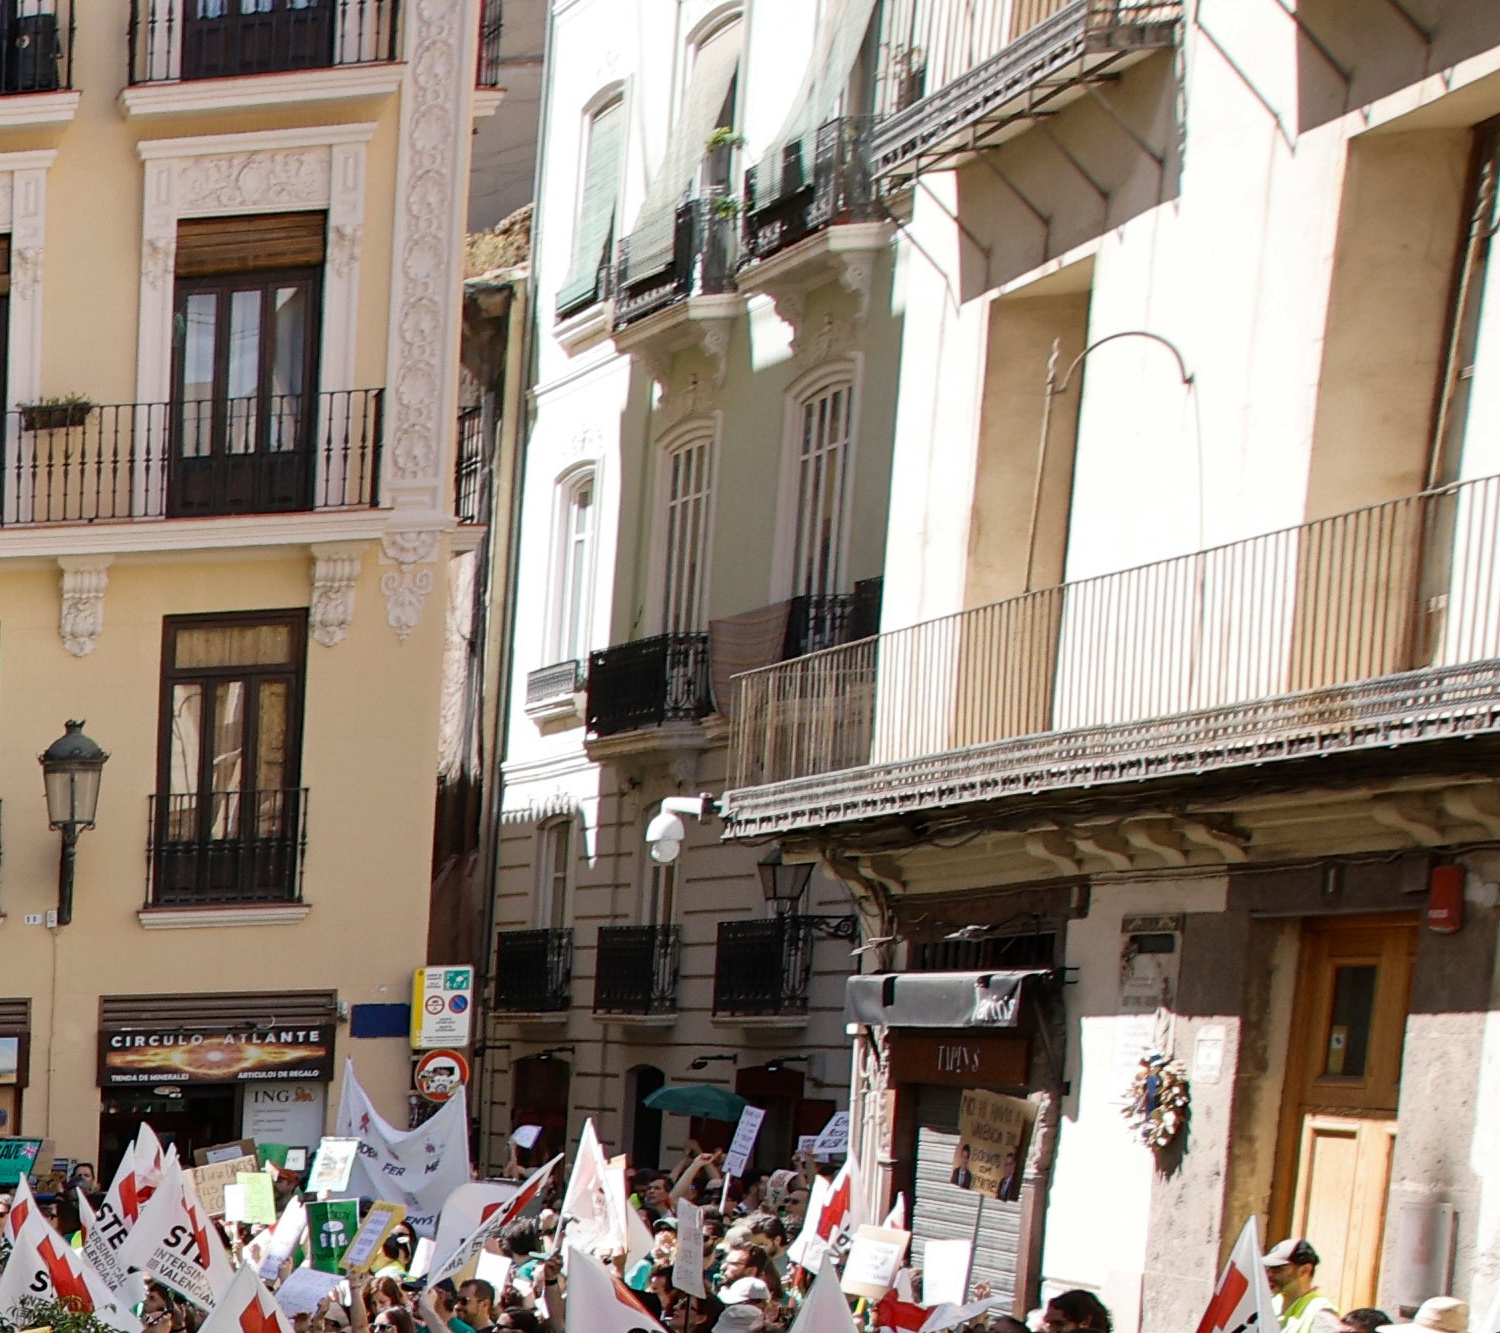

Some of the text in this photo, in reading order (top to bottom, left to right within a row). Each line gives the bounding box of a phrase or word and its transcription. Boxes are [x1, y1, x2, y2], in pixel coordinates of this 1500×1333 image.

[111, 1031, 320, 1047] CIRCULO ATLANTE
[111, 1074, 137, 1082] TIENDA
[238, 1071, 276, 1079] ARTICULOS
[254, 1089, 289, 1103] ING
